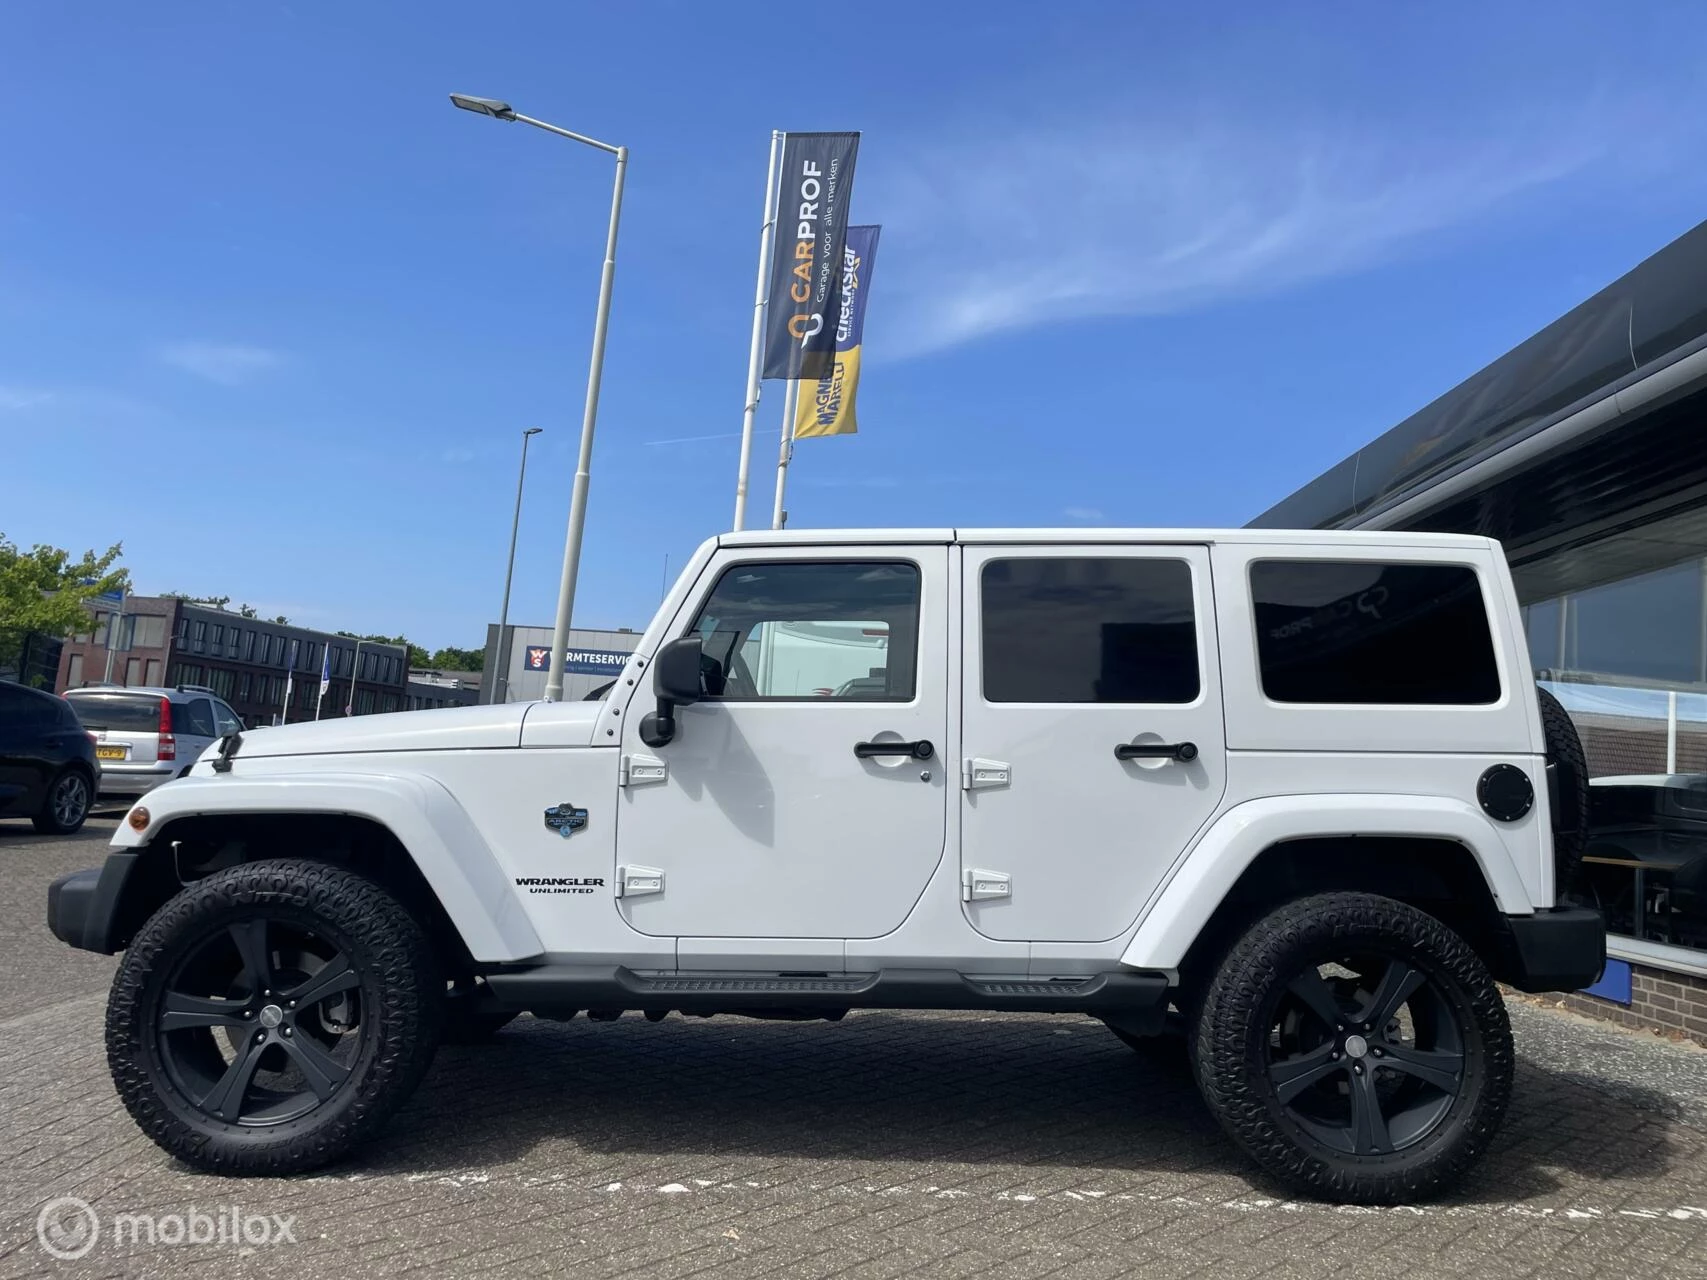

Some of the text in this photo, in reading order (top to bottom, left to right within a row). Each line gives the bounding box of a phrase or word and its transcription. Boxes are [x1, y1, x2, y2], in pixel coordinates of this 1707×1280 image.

[791, 160, 822, 303] CARPROF
[816, 158, 838, 303] Garage voor alle merken
[816, 377, 832, 425] MAGNE
[515, 878, 605, 887] WRANGLER
